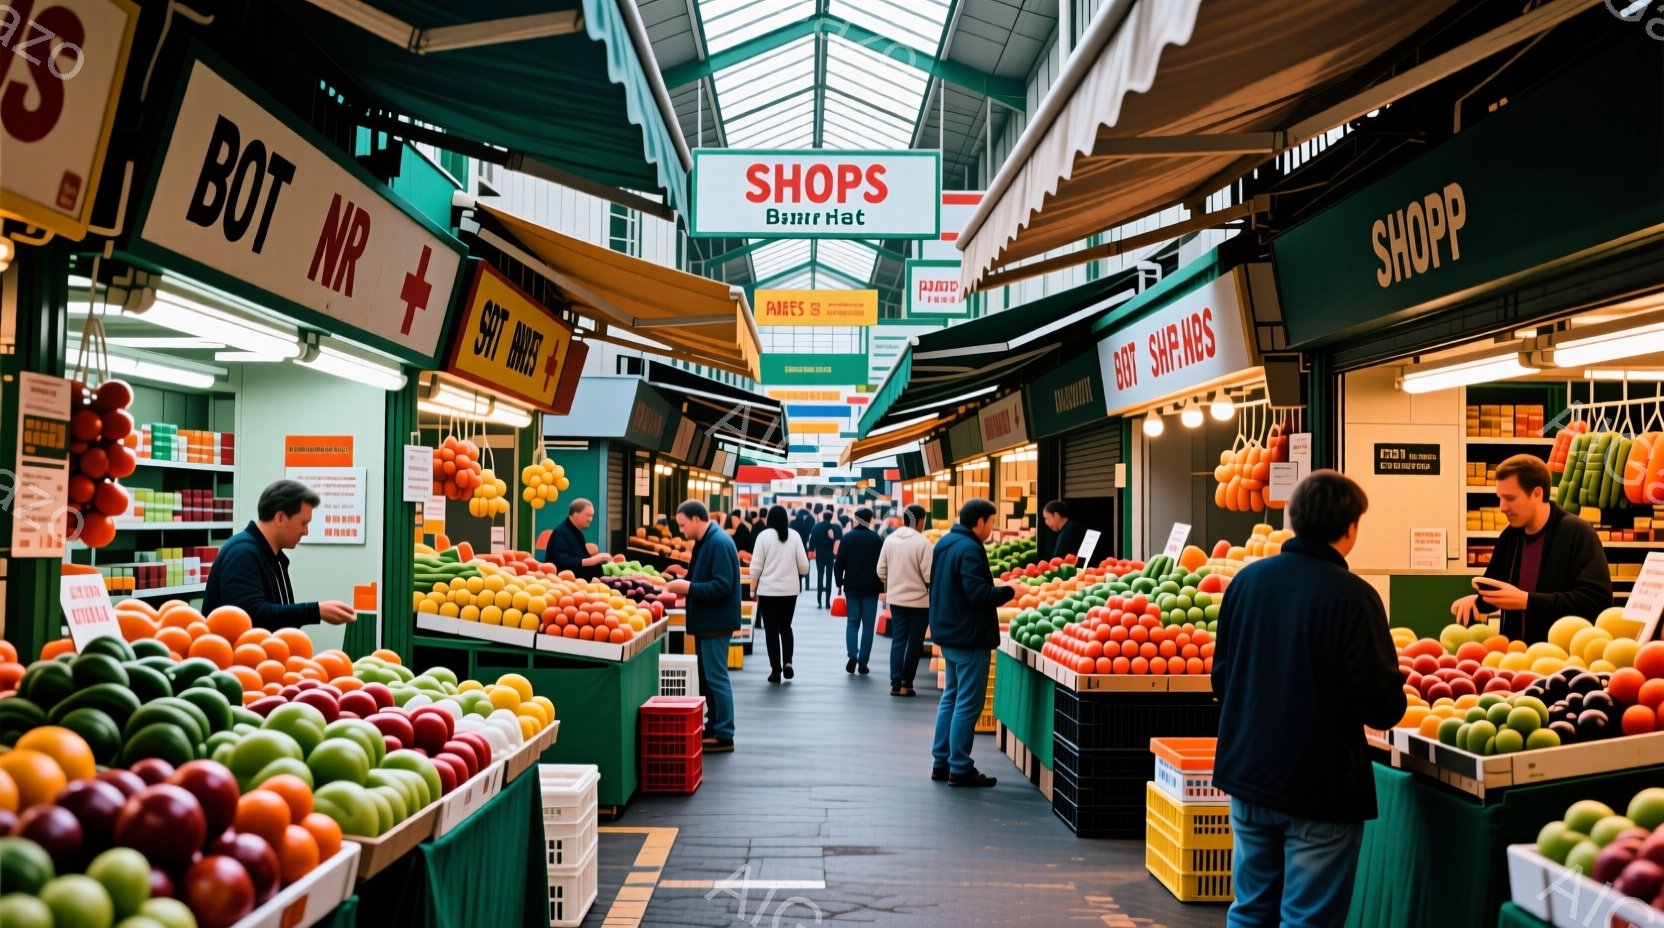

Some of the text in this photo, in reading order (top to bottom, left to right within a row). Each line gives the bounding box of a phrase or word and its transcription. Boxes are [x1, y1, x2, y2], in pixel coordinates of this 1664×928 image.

[186, 114, 371, 298] BOT NR
[745, 163, 888, 204] SHOPS
[1372, 182, 1466, 288] SHOPP
